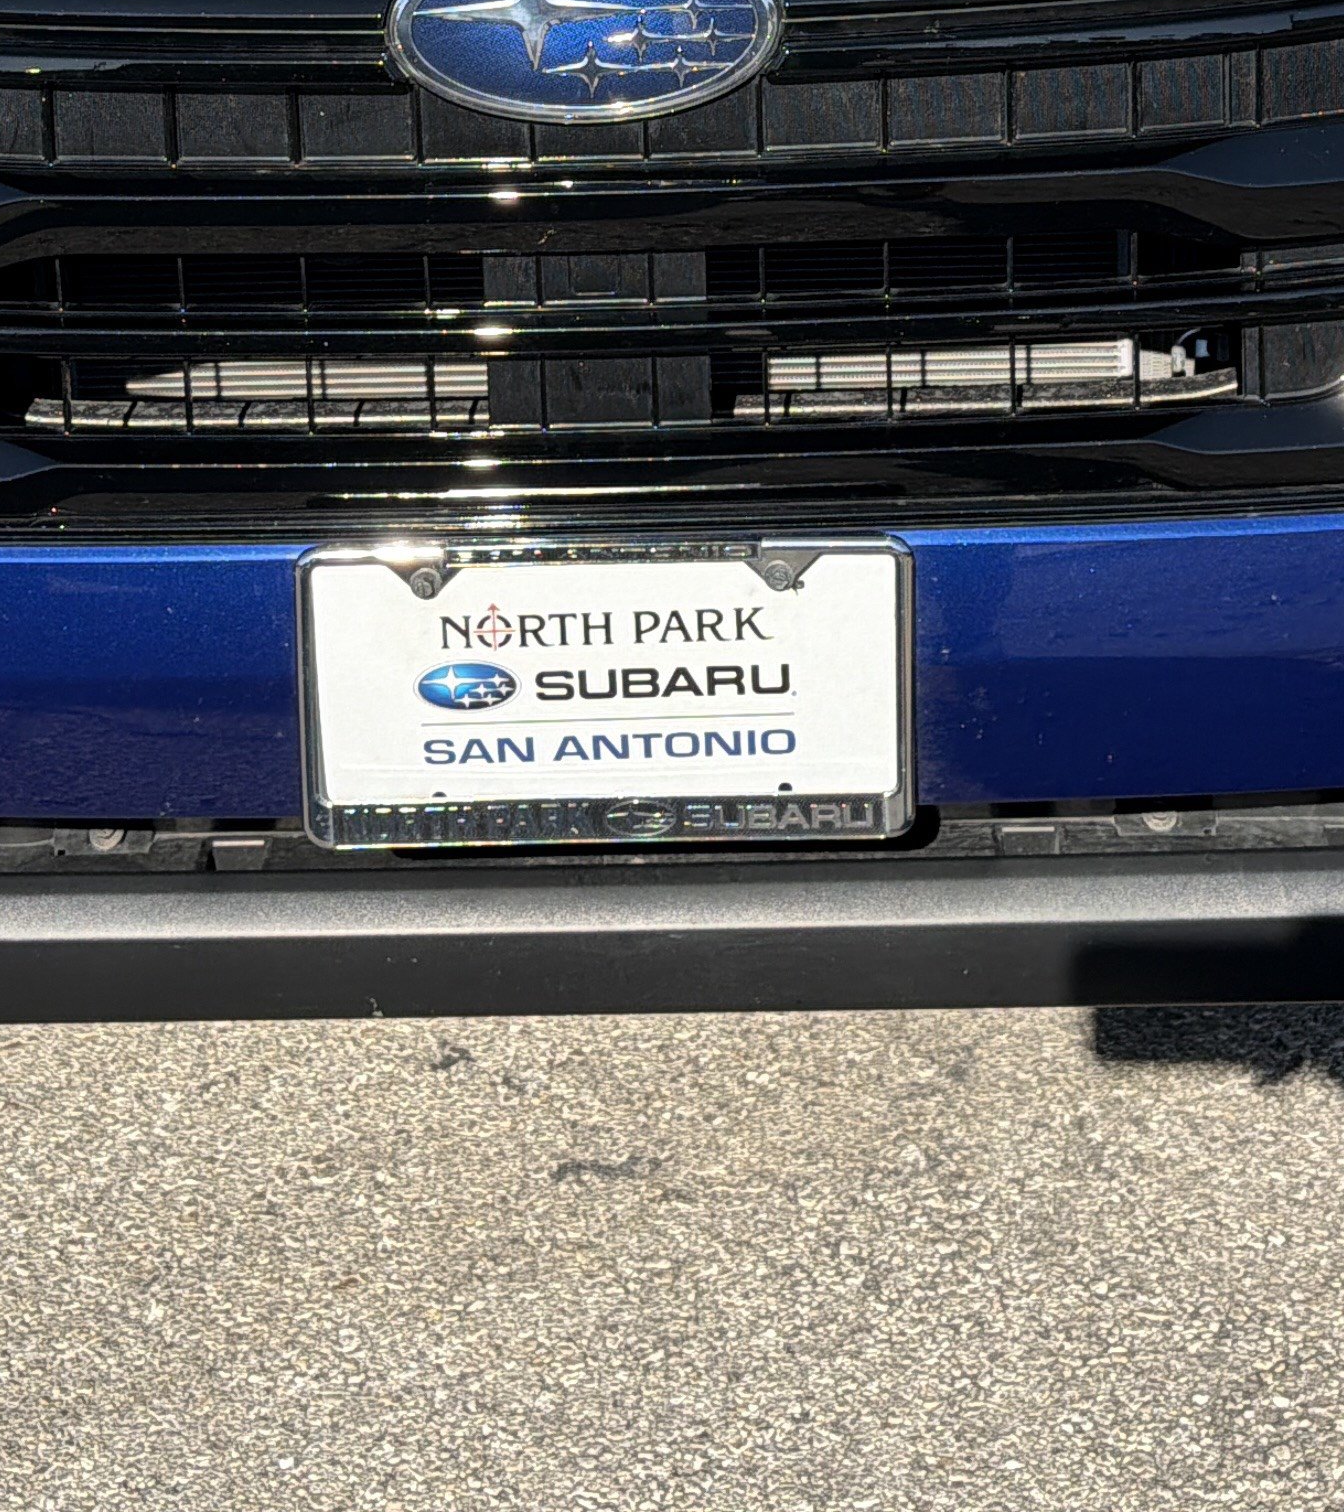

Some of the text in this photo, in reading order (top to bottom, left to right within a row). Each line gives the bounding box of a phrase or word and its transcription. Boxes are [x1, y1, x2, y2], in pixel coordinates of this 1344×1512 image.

[440, 607, 774, 649] NORTH PARK
[536, 664, 790, 700] SUBARU
[423, 729, 796, 764] SAN ANTONIO
[684, 803, 876, 829] SUBARU
